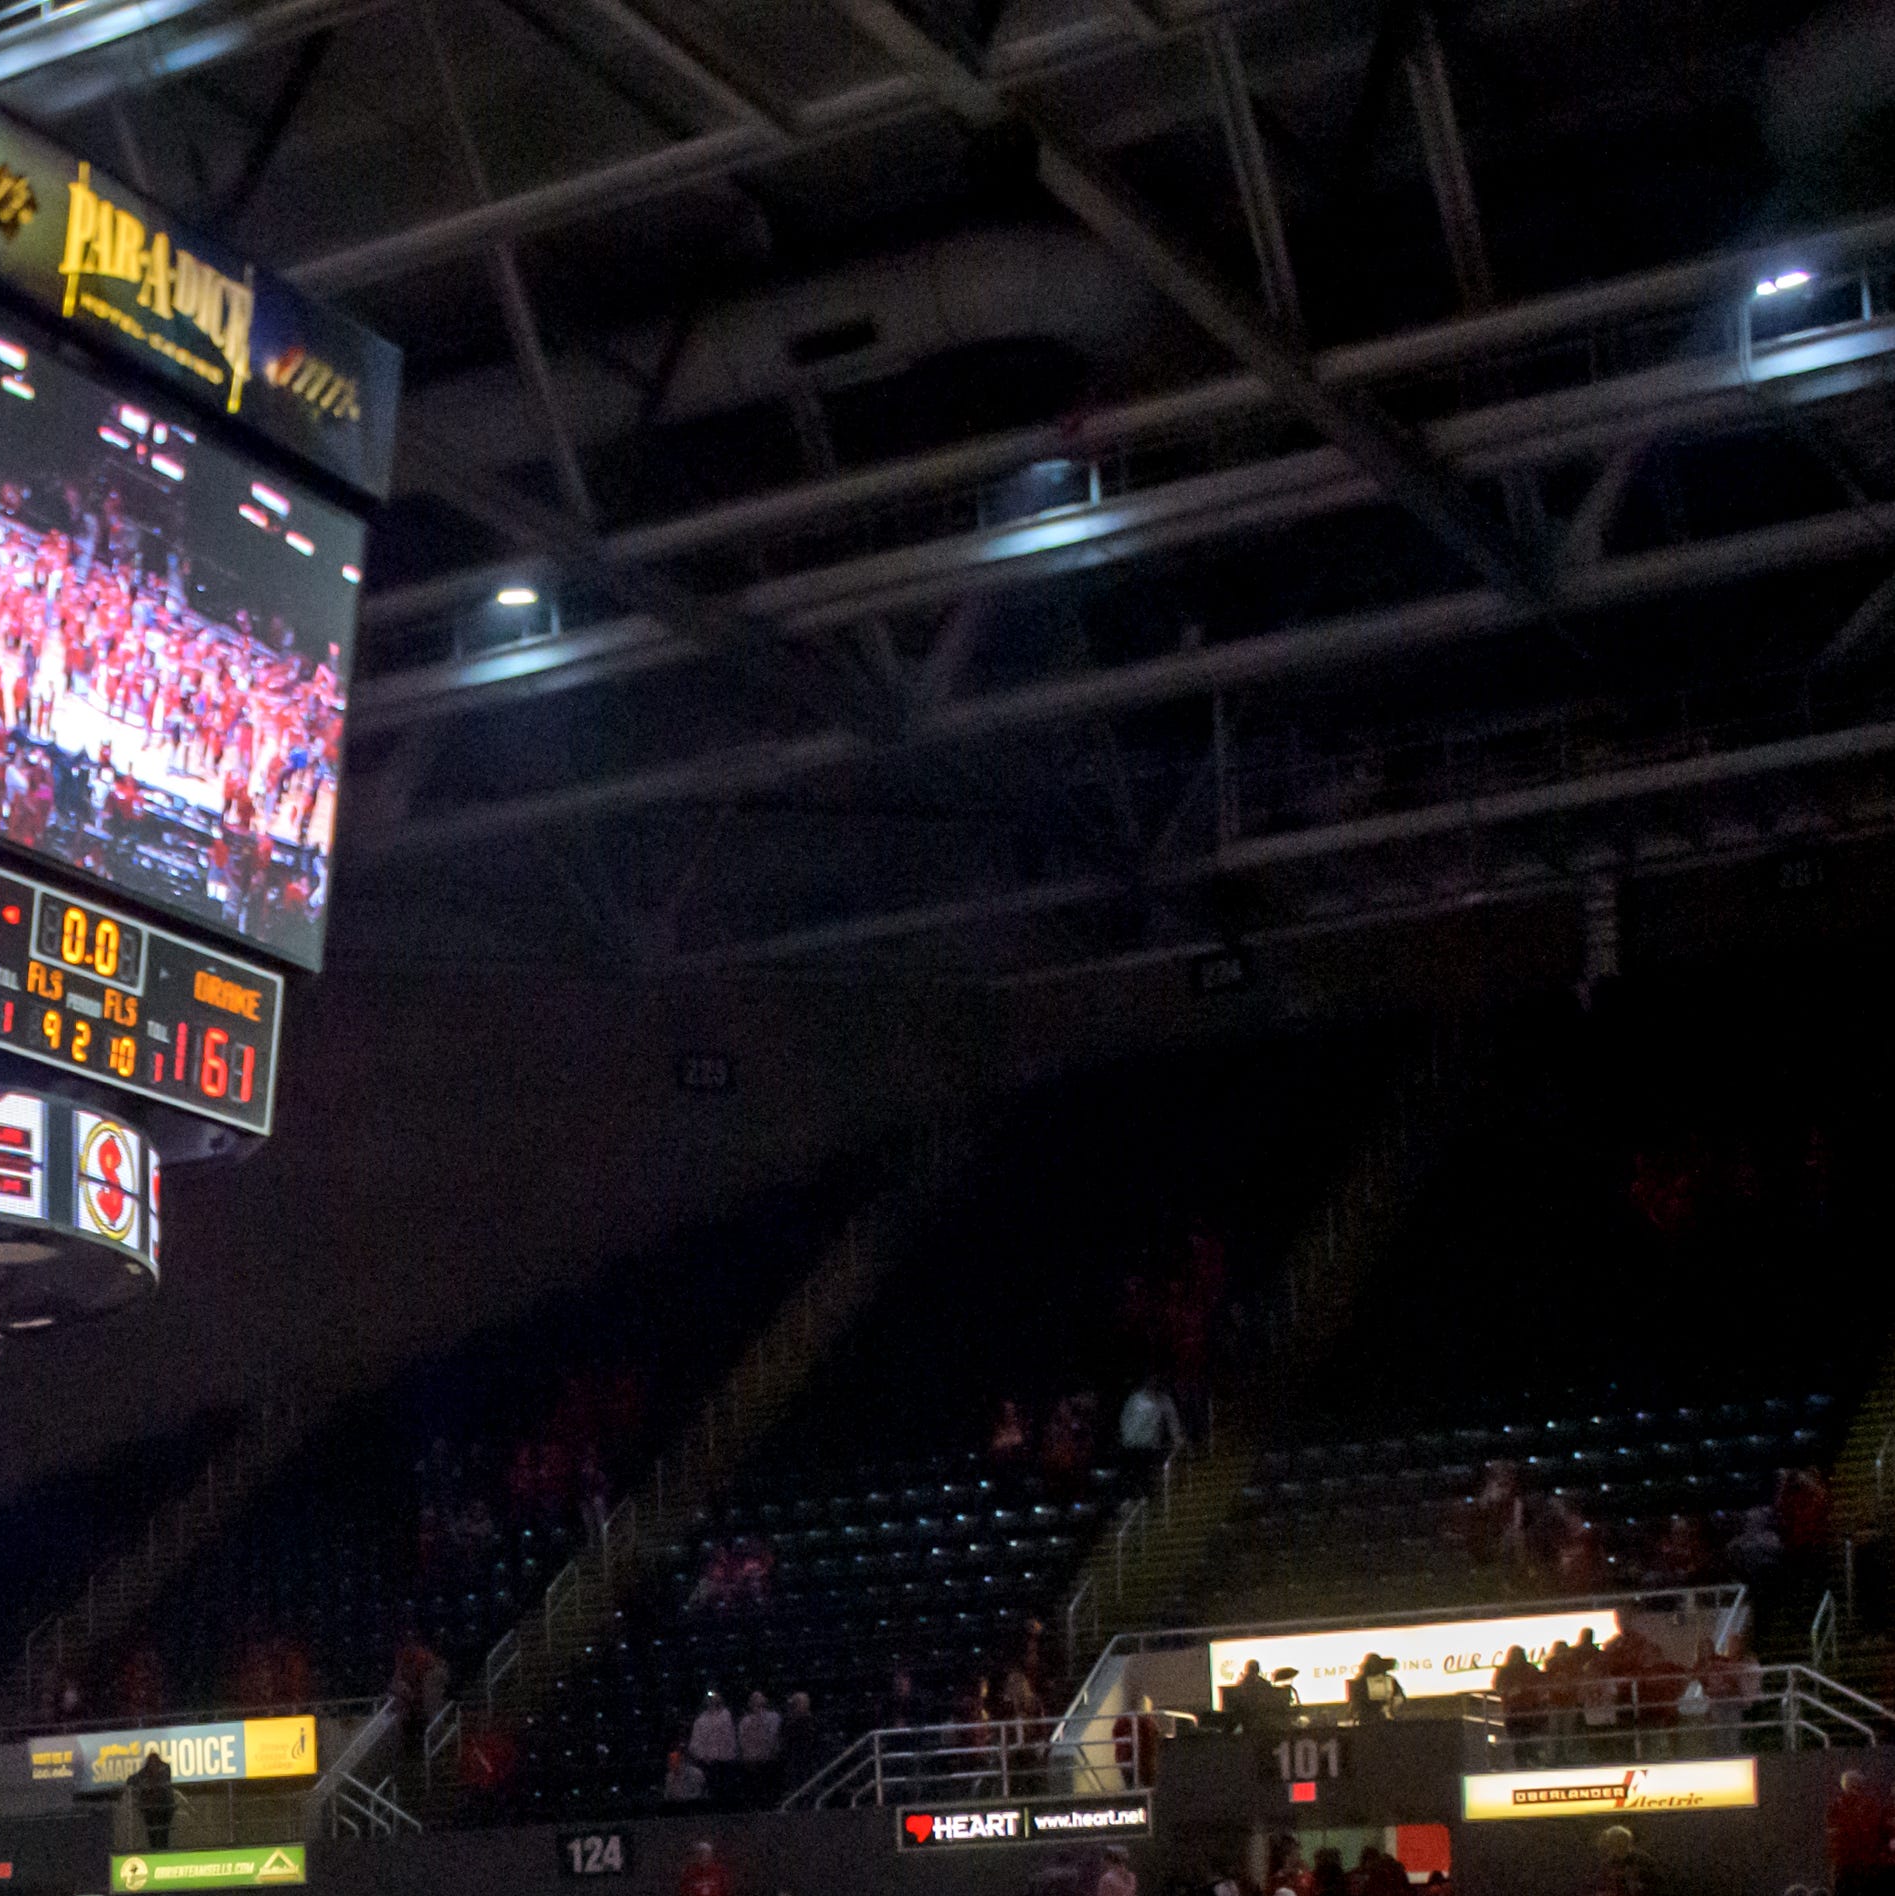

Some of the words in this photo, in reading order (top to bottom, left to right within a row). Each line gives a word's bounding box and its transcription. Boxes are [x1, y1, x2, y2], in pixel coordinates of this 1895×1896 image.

[27, 960, 64, 1001] FLS
[104, 987, 138, 1027] FLS
[1313, 1656, 1433, 1679] EMPOING
[1272, 1738, 1340, 1781] 101
[1515, 1786, 1625, 1803] OBERLANDER
[932, 1811, 1019, 1840] HEART
[1034, 1808, 1146, 1832] www.heart.net
[567, 1835, 623, 1874] 124
